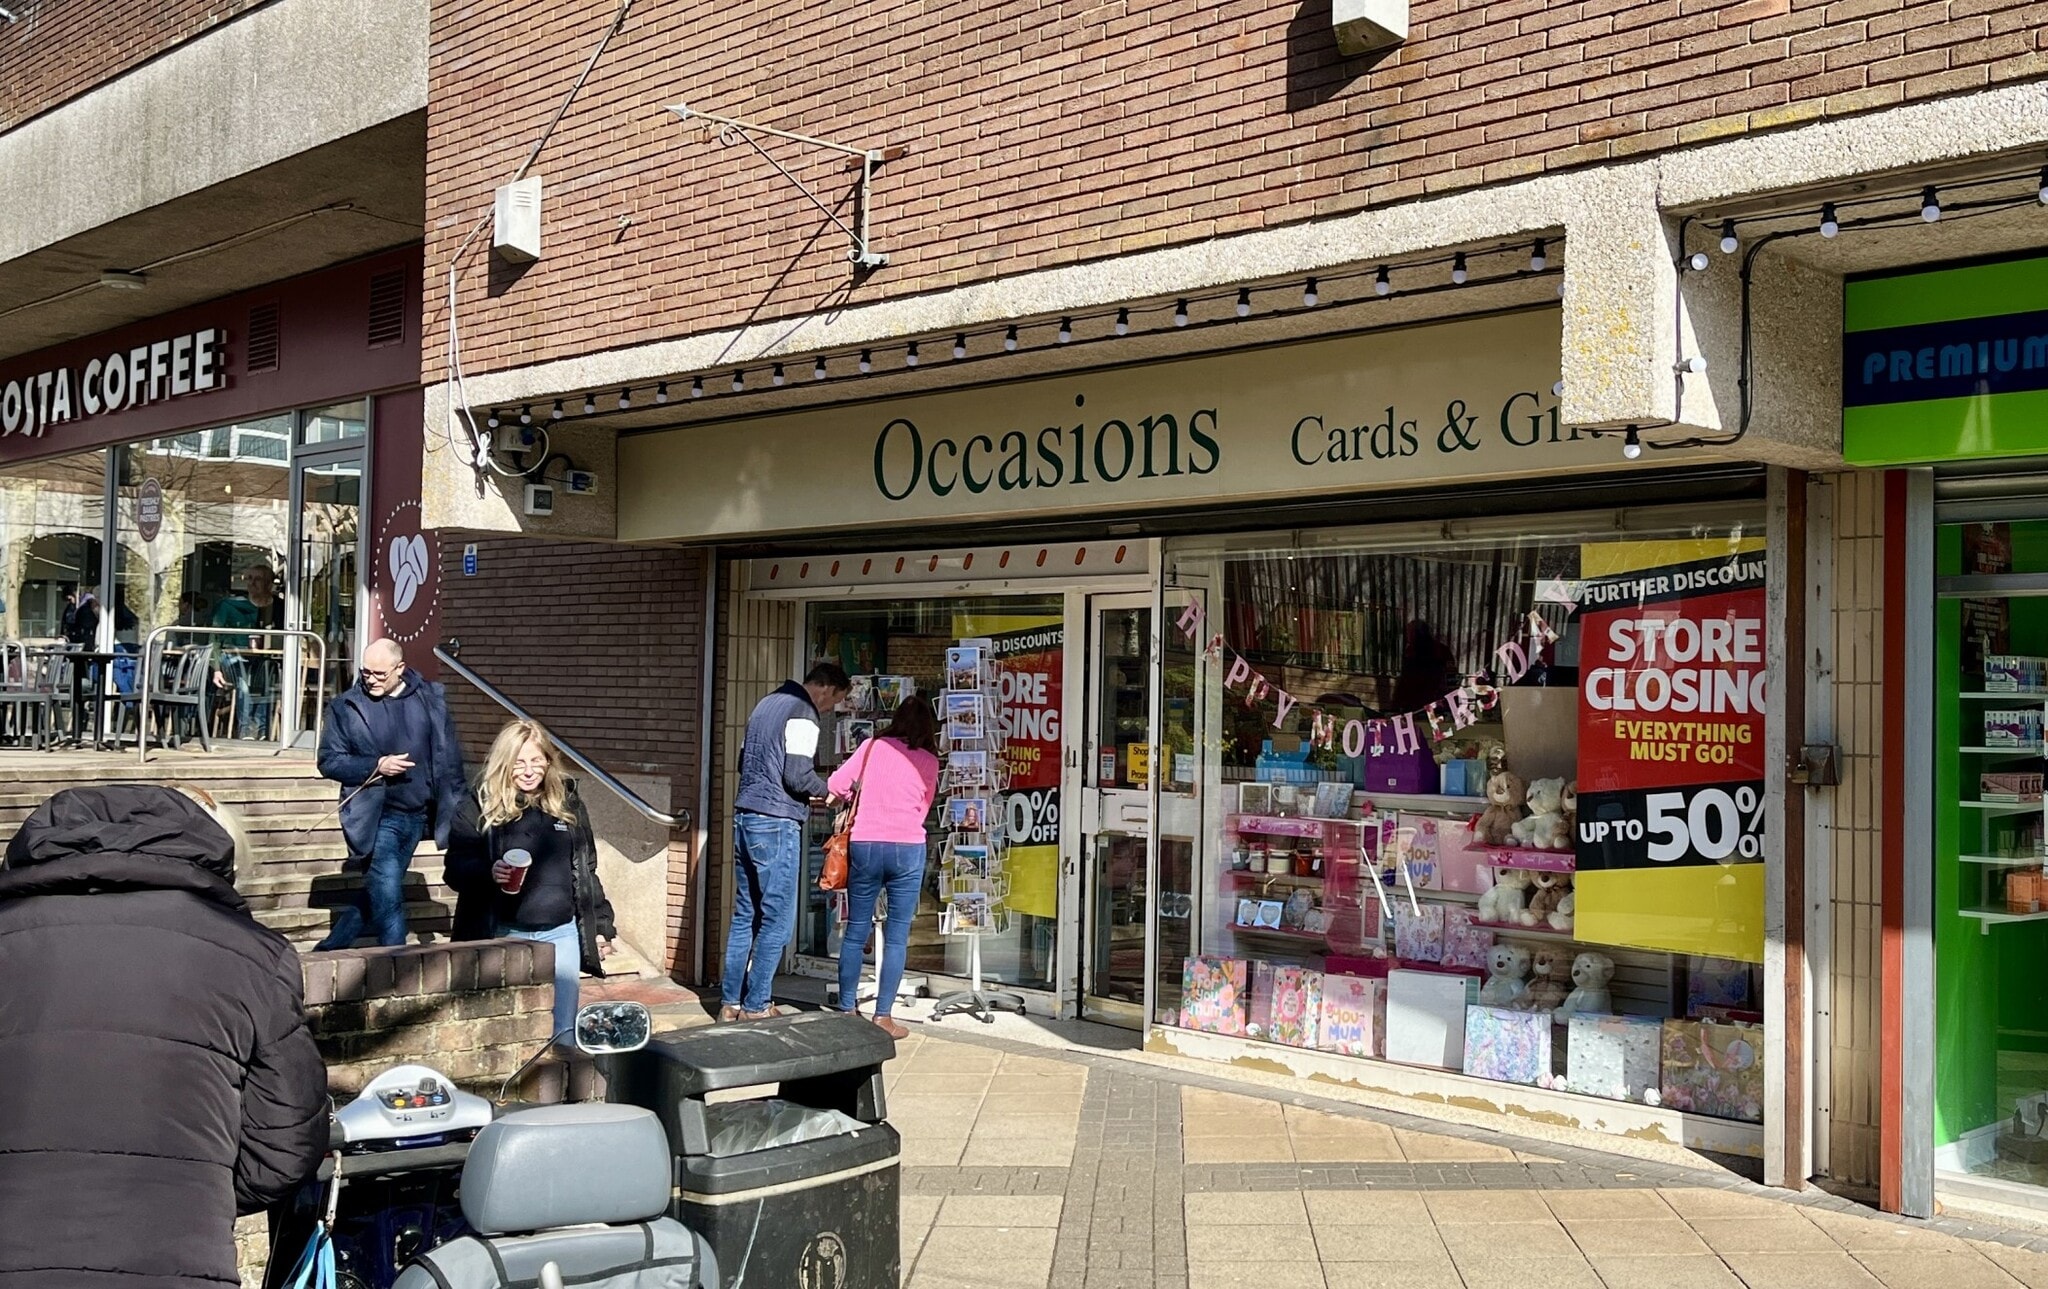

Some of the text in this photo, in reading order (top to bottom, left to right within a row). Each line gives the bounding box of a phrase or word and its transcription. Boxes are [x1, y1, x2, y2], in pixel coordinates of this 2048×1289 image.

[1863, 335, 2048, 384] PREMIUM
[0, 328, 215, 438] OSTA COFFEE
[1291, 406, 1418, 466] Cards
[1437, 399, 1481, 454] &
[873, 394, 1221, 501] Occasions
[1584, 575, 1669, 605] FURTHER
[1002, 630, 1064, 652] DISCOUNTS
[1608, 618, 1761, 663] STORE
[1614, 720, 1752, 744] EVERYTHING
[1630, 741, 1734, 764] MUST GO!
[1031, 824, 1058, 842] OFF
[1580, 822, 1610, 844] UP
[1611, 819, 1644, 841] TO
[1328, 1024, 1362, 1042] MUM
